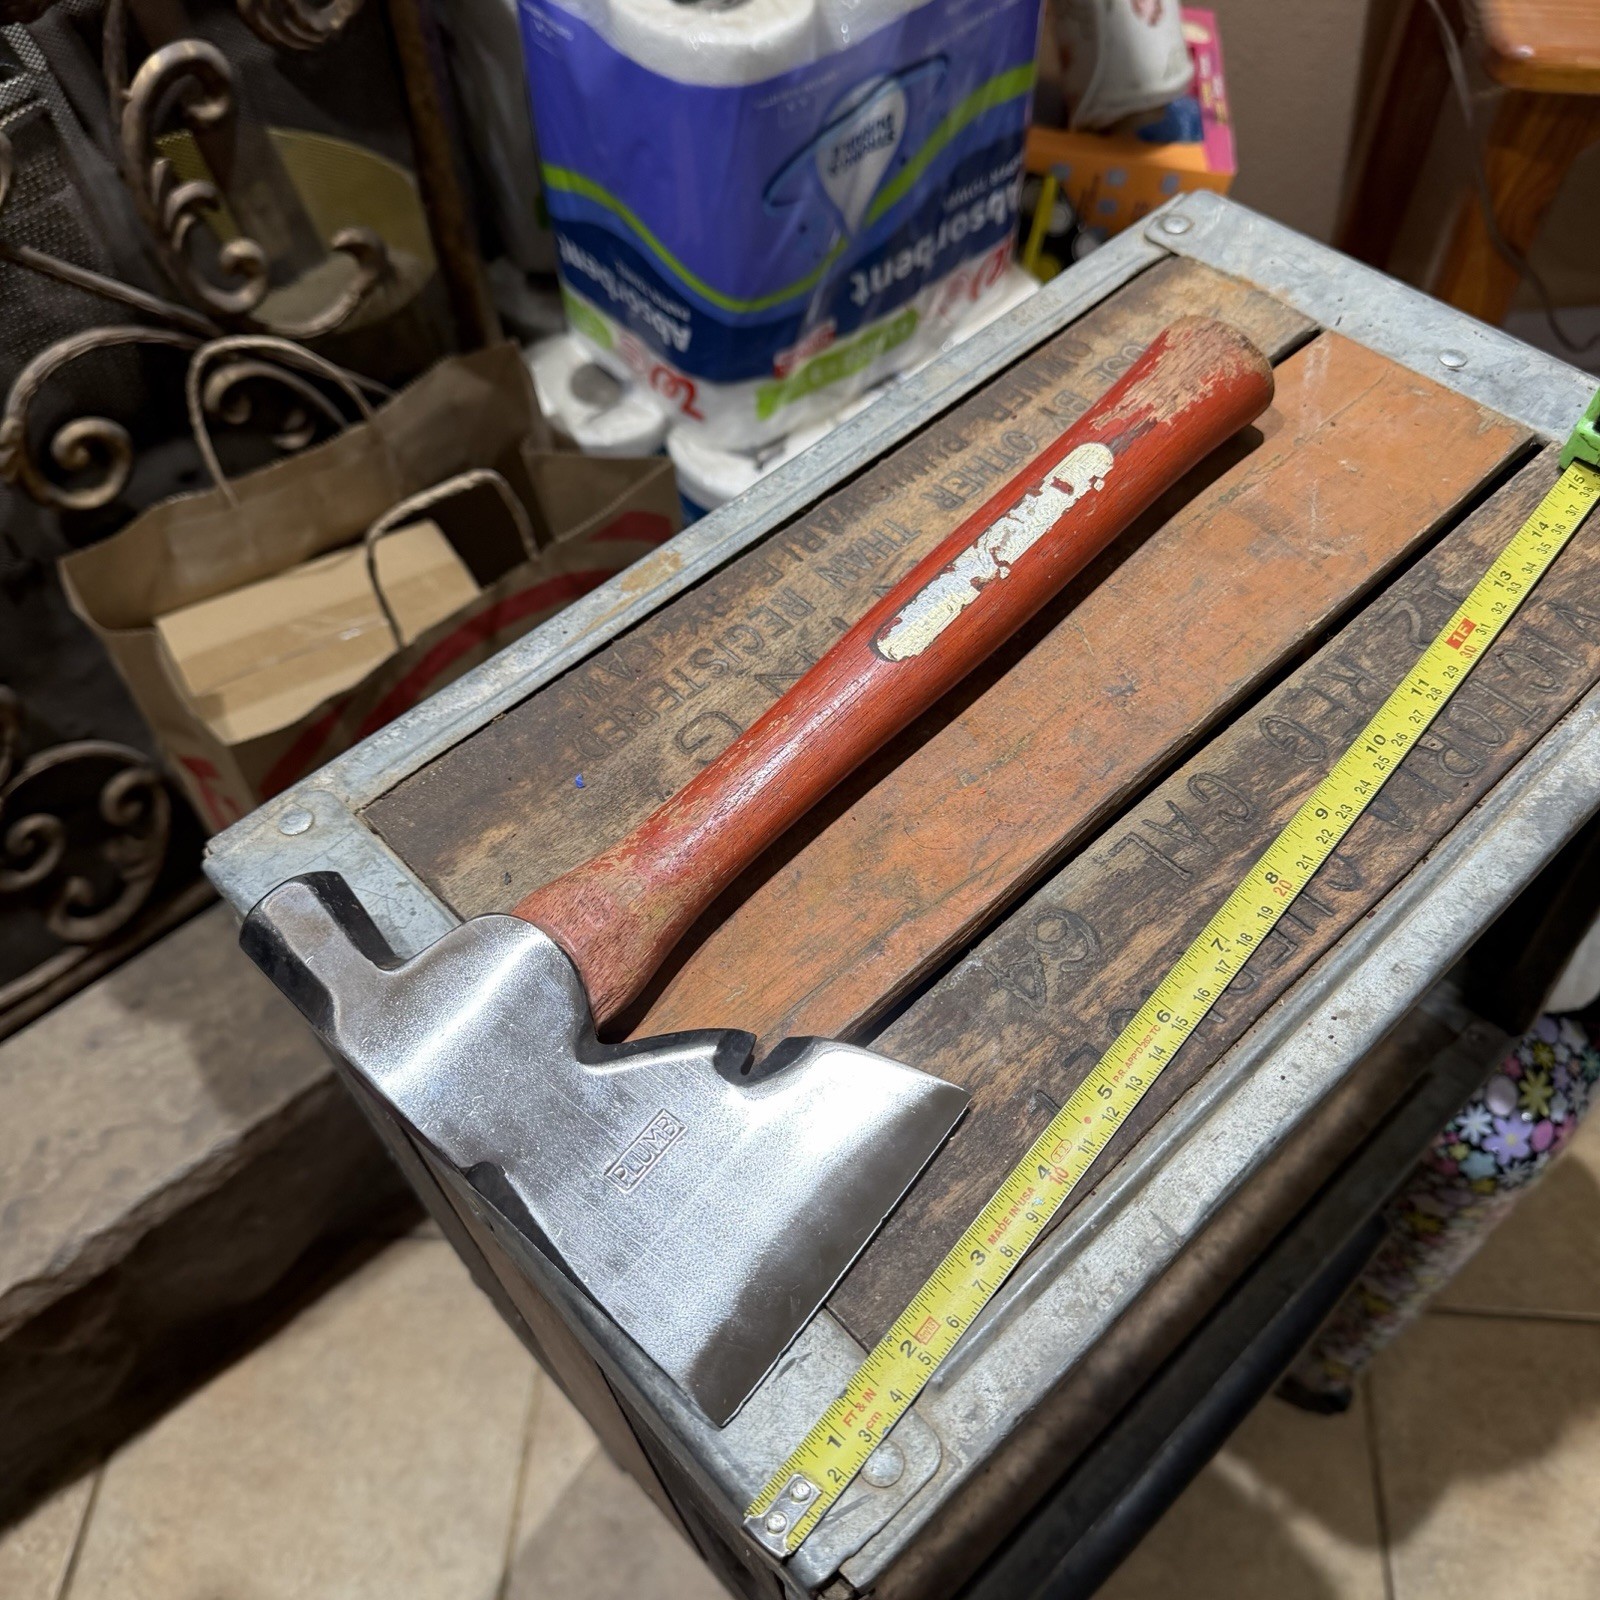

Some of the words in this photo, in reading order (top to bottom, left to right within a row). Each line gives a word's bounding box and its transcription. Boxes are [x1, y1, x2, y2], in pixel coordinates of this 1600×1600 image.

[1038, 389, 1089, 432] BY
[919, 428, 1037, 515] OTHER
[813, 517, 920, 593] THAN
[569, 587, 814, 761] REGISTERED
[1365, 601, 1600, 822] VICTORIA
[824, 1434, 841, 1451] 1
[897, 1338, 917, 1358] 2
[967, 1247, 987, 1267] 3
[1032, 1162, 1052, 1182] 4
[1095, 1083, 1113, 1101] 5
[1154, 1007, 1172, 1024] 6
[1209, 937, 1226, 953] 7
[1263, 870, 1279, 885] 8
[1314, 806, 1329, 821] 9
[1364, 732, 1386, 756] 10
[1409, 677, 1428, 698] 11
[1449, 621, 1470, 644] 1F
[1492, 569, 1511, 590] 13
[1530, 520, 1549, 540] 14
[1566, 473, 1585, 493] 15
[825, 1467, 842, 1483] 2
[857, 1428, 873, 1443] 3
[886, 1389, 902, 1404] 4
[916, 1351, 932, 1366] 5
[944, 1314, 960, 1329] 6
[971, 1278, 987, 1293] 7
[999, 1244, 1014, 1258] 8
[1024, 1210, 1039, 1224] 9
[1047, 1165, 1069, 1188] 10
[1076, 1137, 1095, 1157] 11
[1100, 1105, 1119, 1125] 12
[1124, 1074, 1143, 1094] 13
[1146, 1043, 1166, 1063] 14
[1169, 1014, 1188, 1033] 15
[1191, 985, 1210, 1005] 16
[1213, 958, 1231, 977] 17
[1234, 930, 1252, 949] 18
[1255, 903, 1273, 922] 19
[1271, 877, 1293, 898] 20
[1294, 852, 1313, 871] 21
[1315, 826, 1334, 846] 22
[1334, 802, 1352, 821] 23
[1353, 777, 1372, 796] 24
[1372, 753, 1389, 772] 25
[1390, 730, 1407, 748] 26
[1407, 708, 1424, 725] 27
[1425, 685, 1442, 703] 28
[1442, 663, 1458, 680] 29
[1458, 642, 1477, 661] 30
[1474, 621, 1491, 638] 31
[1490, 599, 1506, 616] 32
[1506, 579, 1521, 595] 33
[1521, 559, 1536, 576] 34
[1536, 540, 1551, 556] 35
[1550, 521, 1566, 537] 36
[1564, 503, 1578, 518] 37
[1579, 484, 1594, 499] 38
[982, 908, 1101, 1011] 64
[1112, 1066, 1128, 1083] P.R.
[1123, 1045, 1144, 1068] APP'D
[1149, 1024, 1161, 1036] TC
[611, 1115, 680, 1188] PLUMB
[986, 1216, 1012, 1245] MADE
[1007, 1203, 1022, 1218] IN
[1016, 1185, 1035, 1207] USA
[842, 1409, 859, 1427] FT
[852, 1399, 867, 1413] &
[862, 1387, 877, 1403] IN
[864, 1410, 882, 1429] cm
